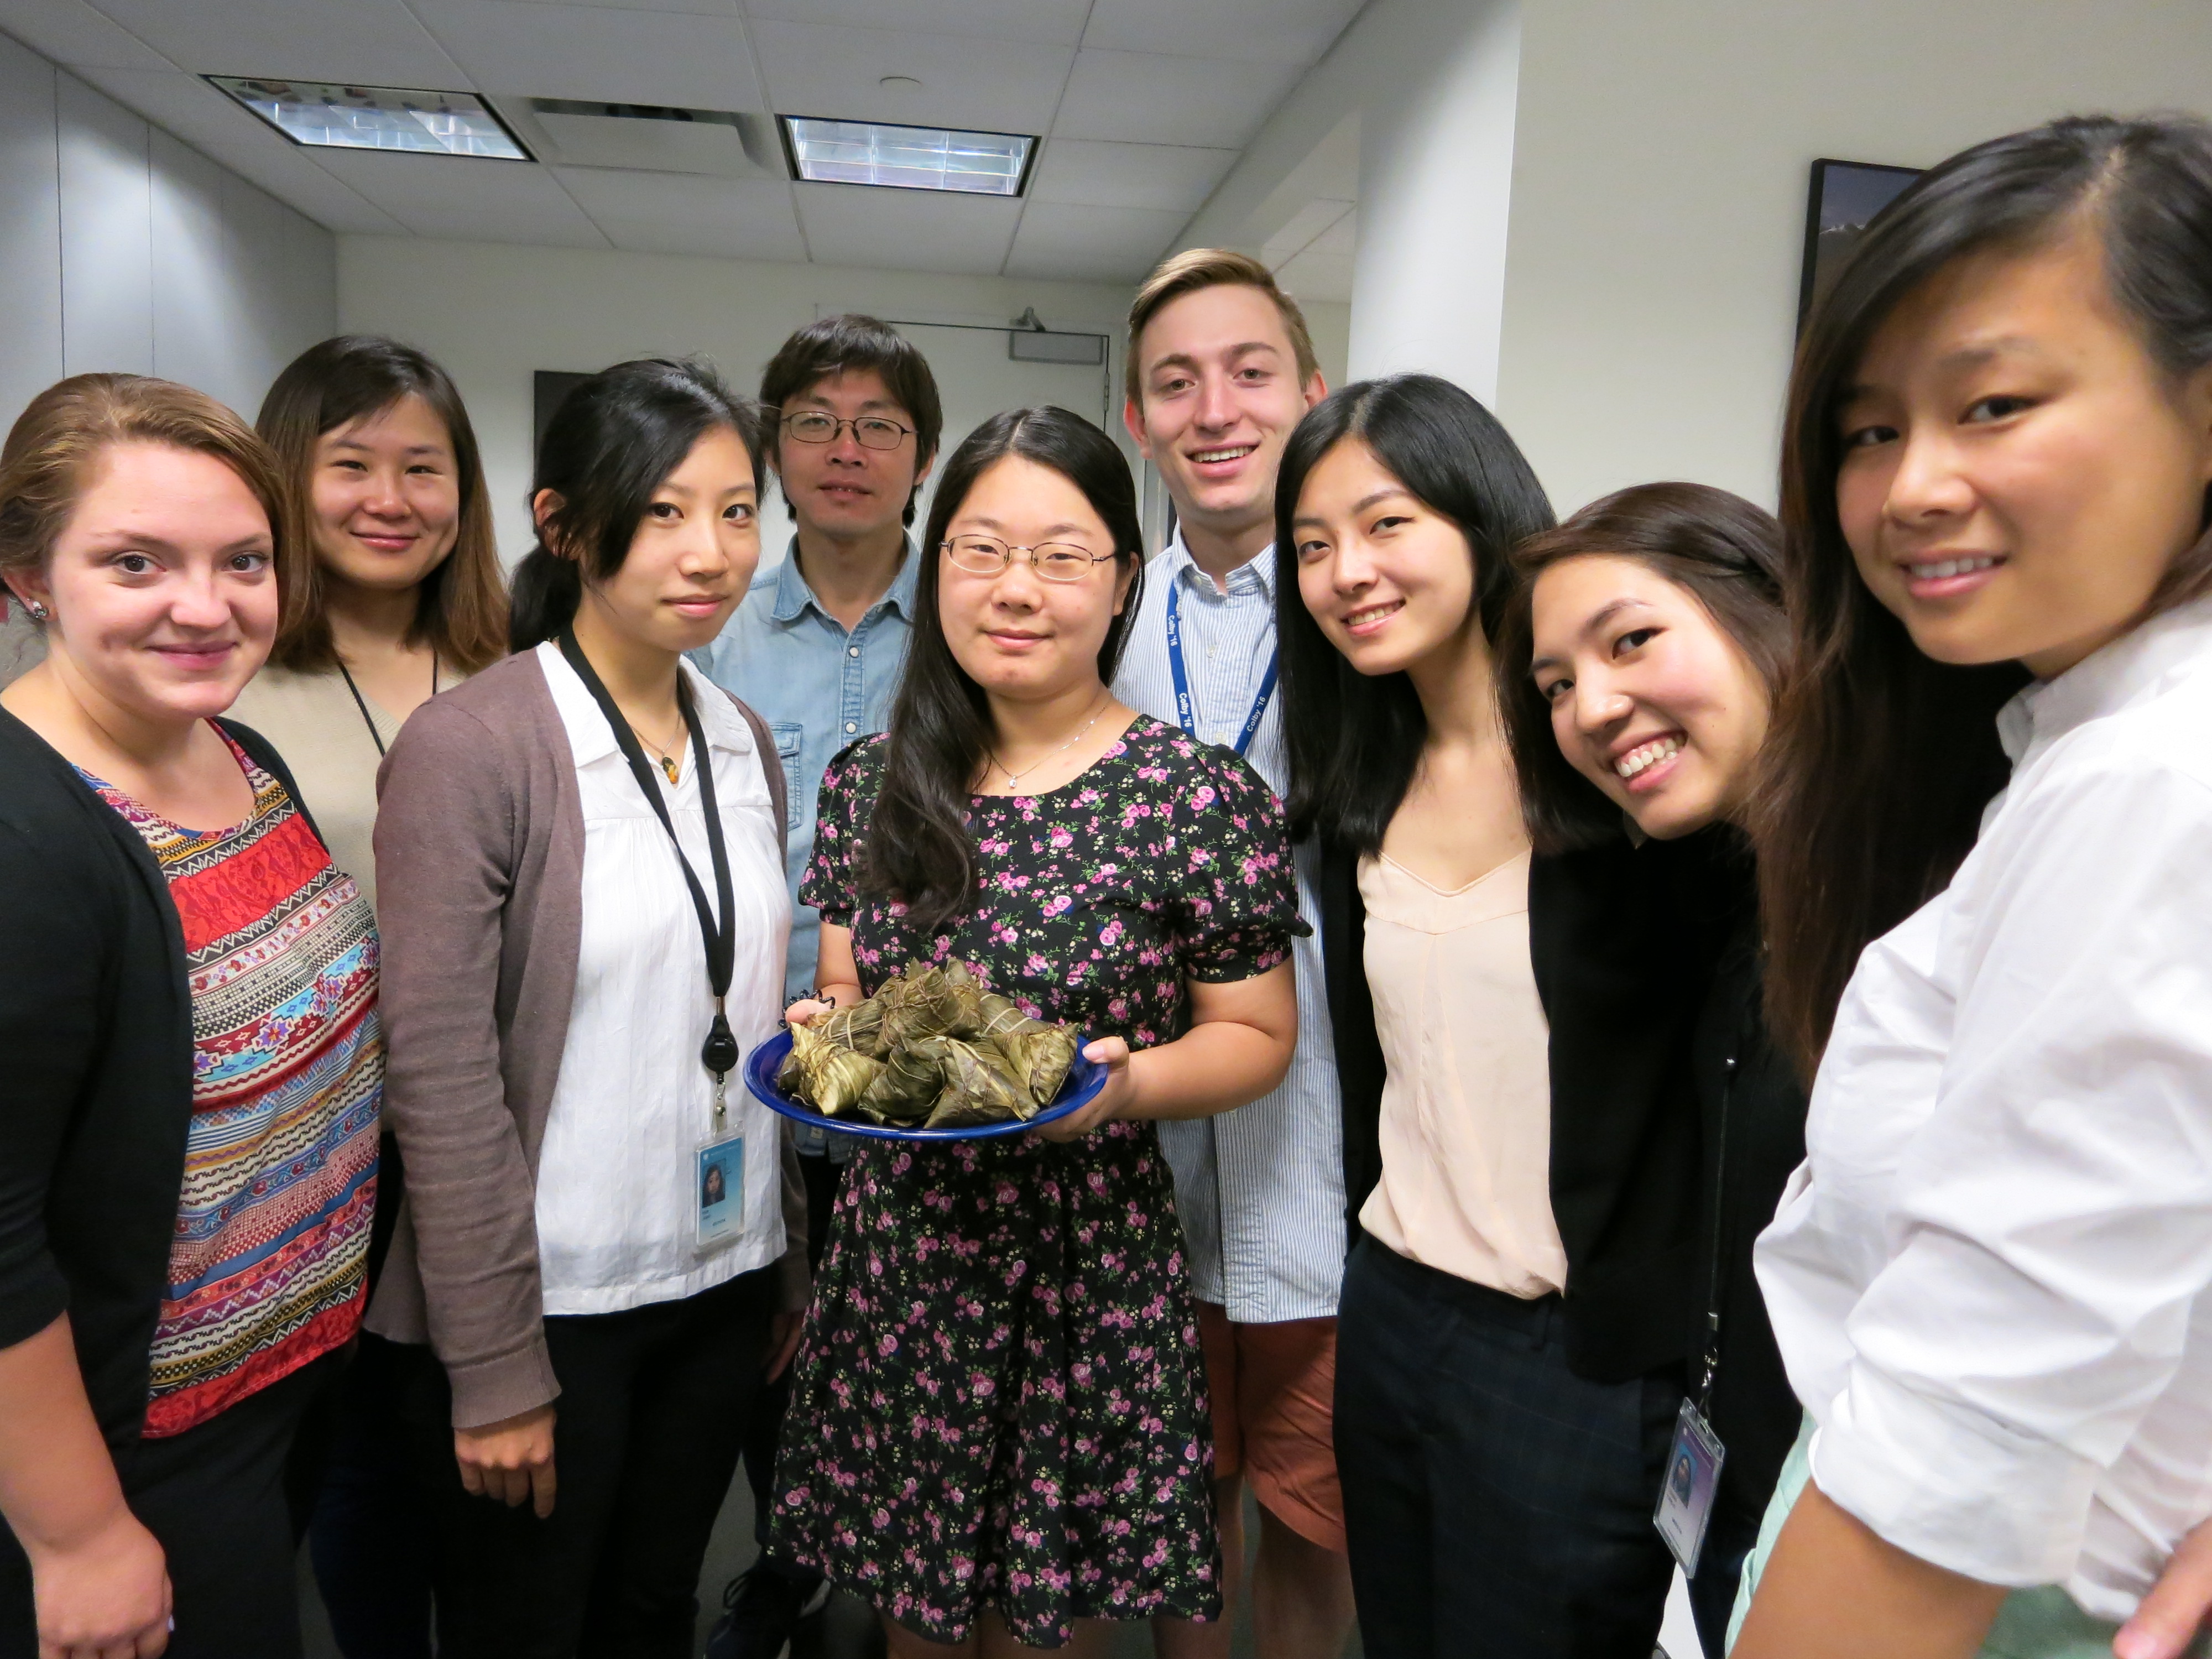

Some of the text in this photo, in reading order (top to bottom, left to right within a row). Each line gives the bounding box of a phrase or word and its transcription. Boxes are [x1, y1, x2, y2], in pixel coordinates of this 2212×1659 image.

[1170, 635, 1178, 646] '16
[1179, 692, 1192, 727] Colby '16
[1246, 696, 1266, 732] Colby '16
